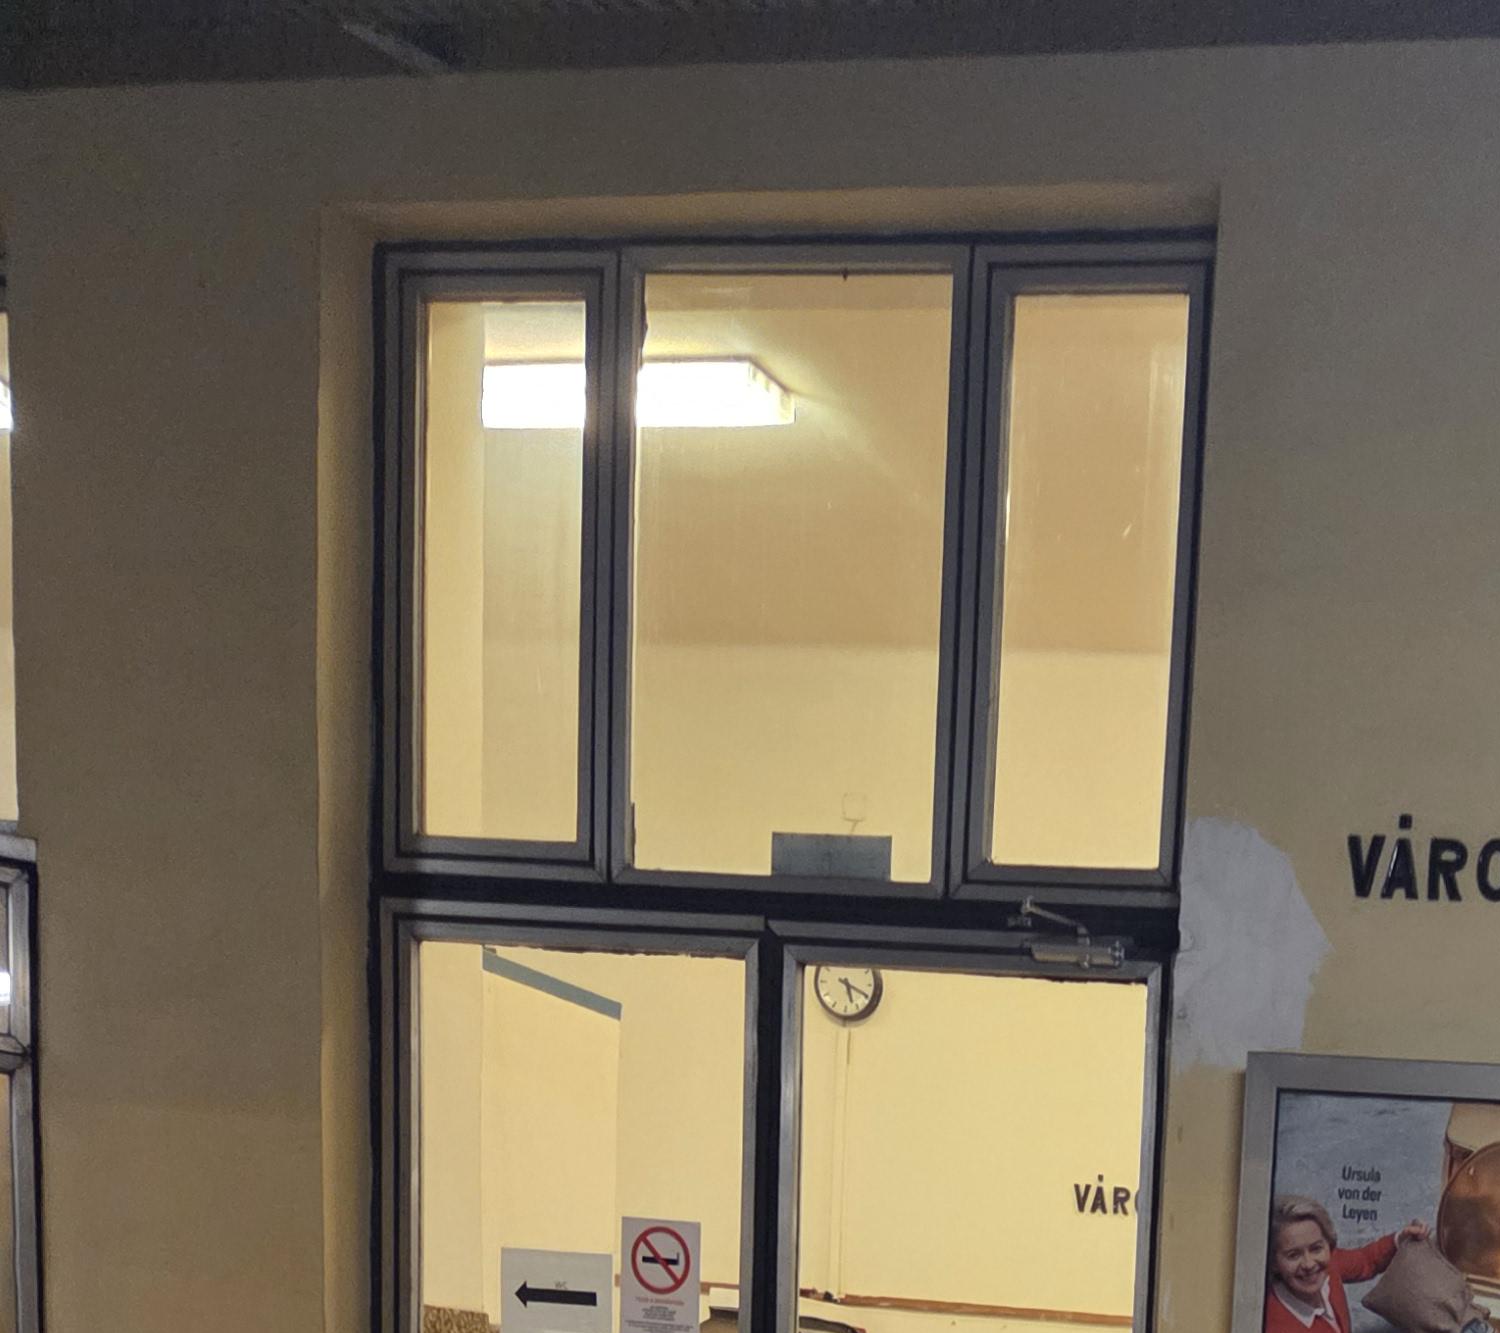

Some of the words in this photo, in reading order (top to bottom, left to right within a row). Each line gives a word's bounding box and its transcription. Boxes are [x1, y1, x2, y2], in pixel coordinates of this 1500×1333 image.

[1342, 1165, 1381, 1182] Ursula
[1073, 1174, 1139, 1216] VÁR
[1338, 1188, 1360, 1201] von
[1362, 1186, 1382, 1202] der
[1342, 1203, 1378, 1223] Leyen
